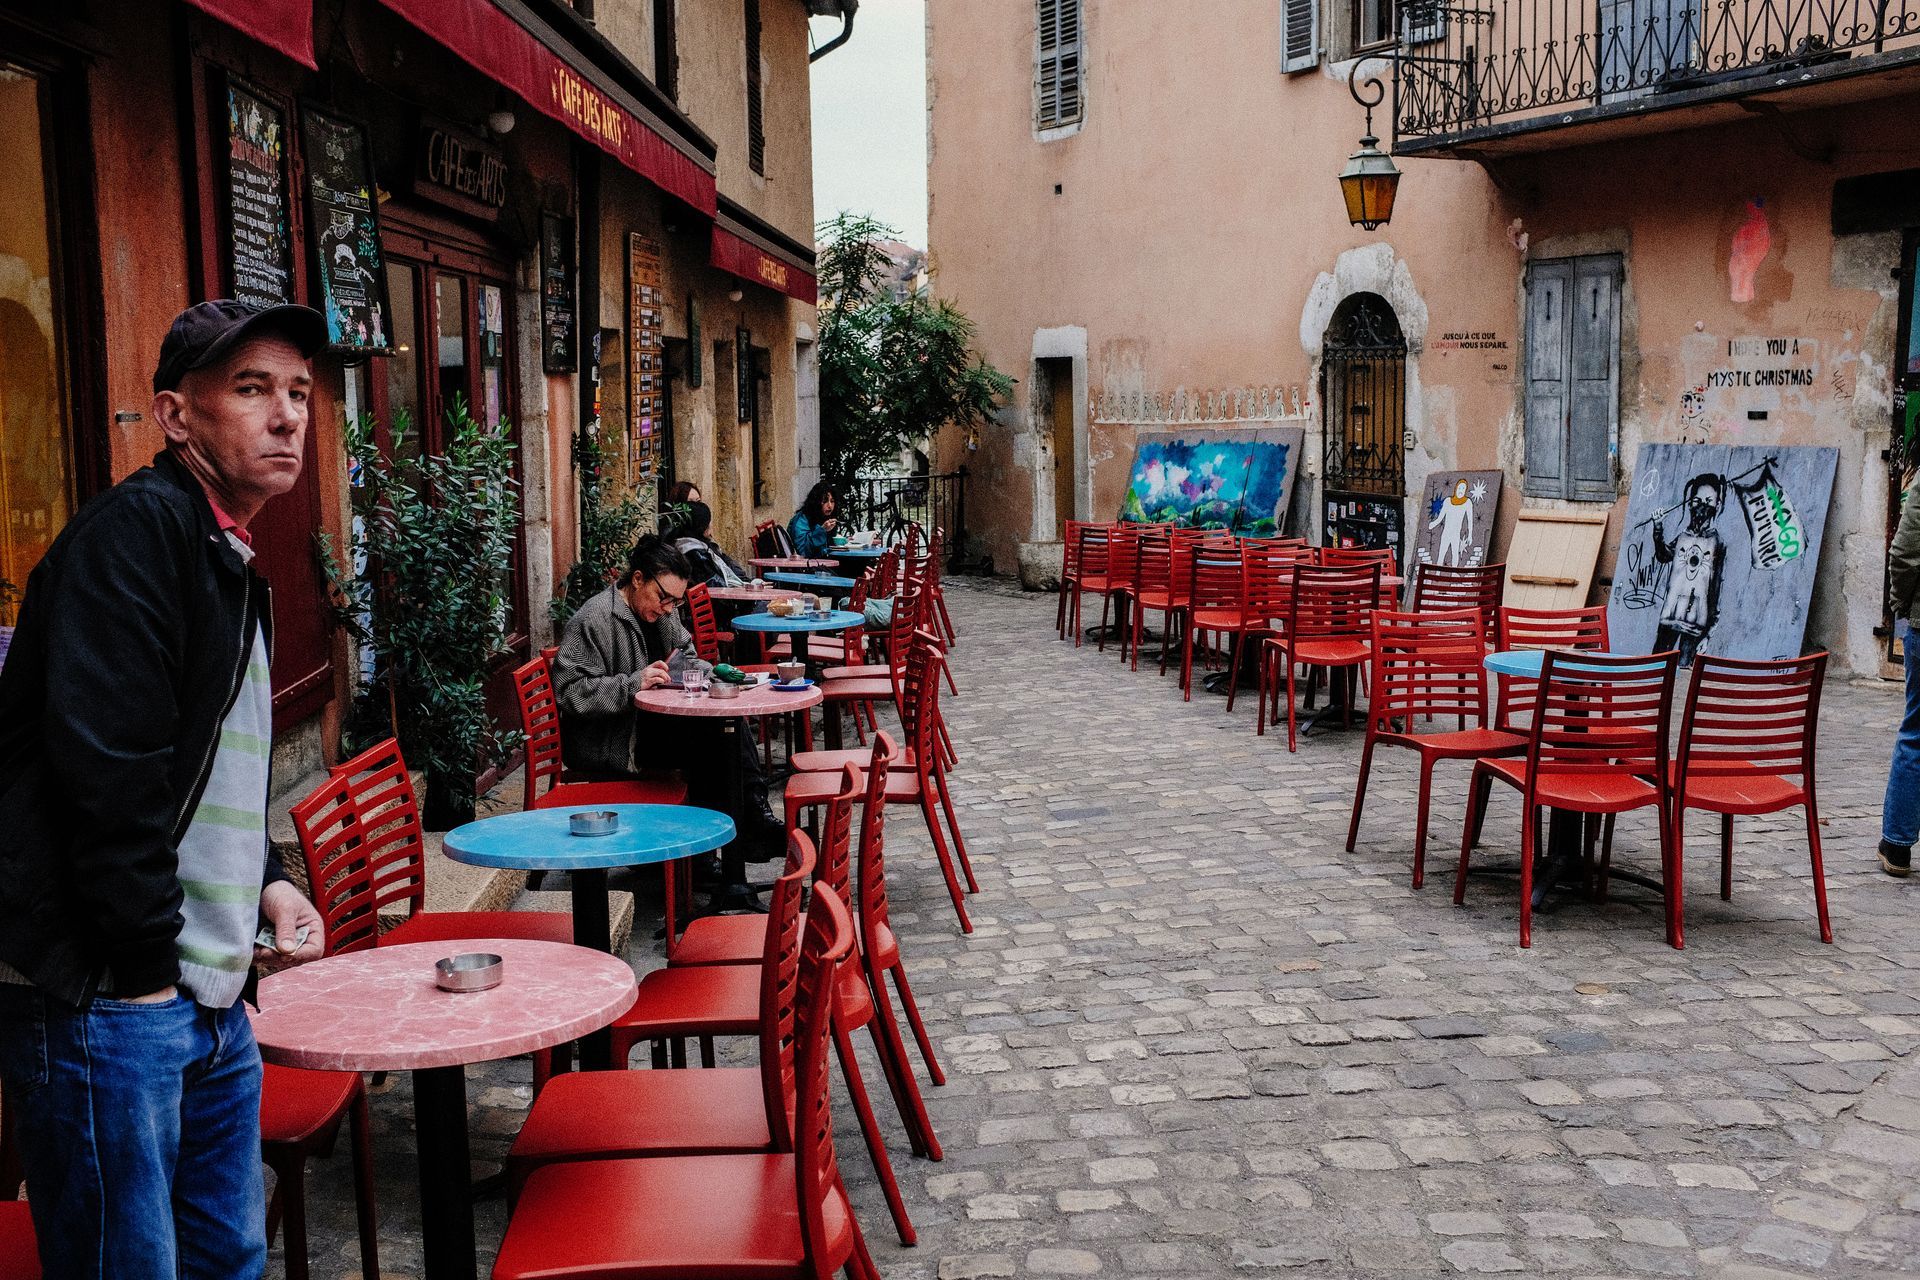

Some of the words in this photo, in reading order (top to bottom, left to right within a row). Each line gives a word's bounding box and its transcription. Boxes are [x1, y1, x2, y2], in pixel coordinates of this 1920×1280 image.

[583, 88, 600, 134] DES
[602, 103, 622, 147] ARTS
[475, 151, 508, 208] ARTS
[1460, 341, 1479, 349] NOUS
[1471, 332, 1480, 340] CE
[1481, 332, 1496, 340] QUE
[1728, 340, 1732, 357] I
[1766, 339, 1787, 356] YOU
[1792, 339, 1799, 355] A
[1707, 370, 1751, 388] MYSTIC
[1754, 369, 1813, 386] CHRISTMAS
[1749, 495, 1782, 567] FUTURE
[1778, 526, 1801, 559] GO
